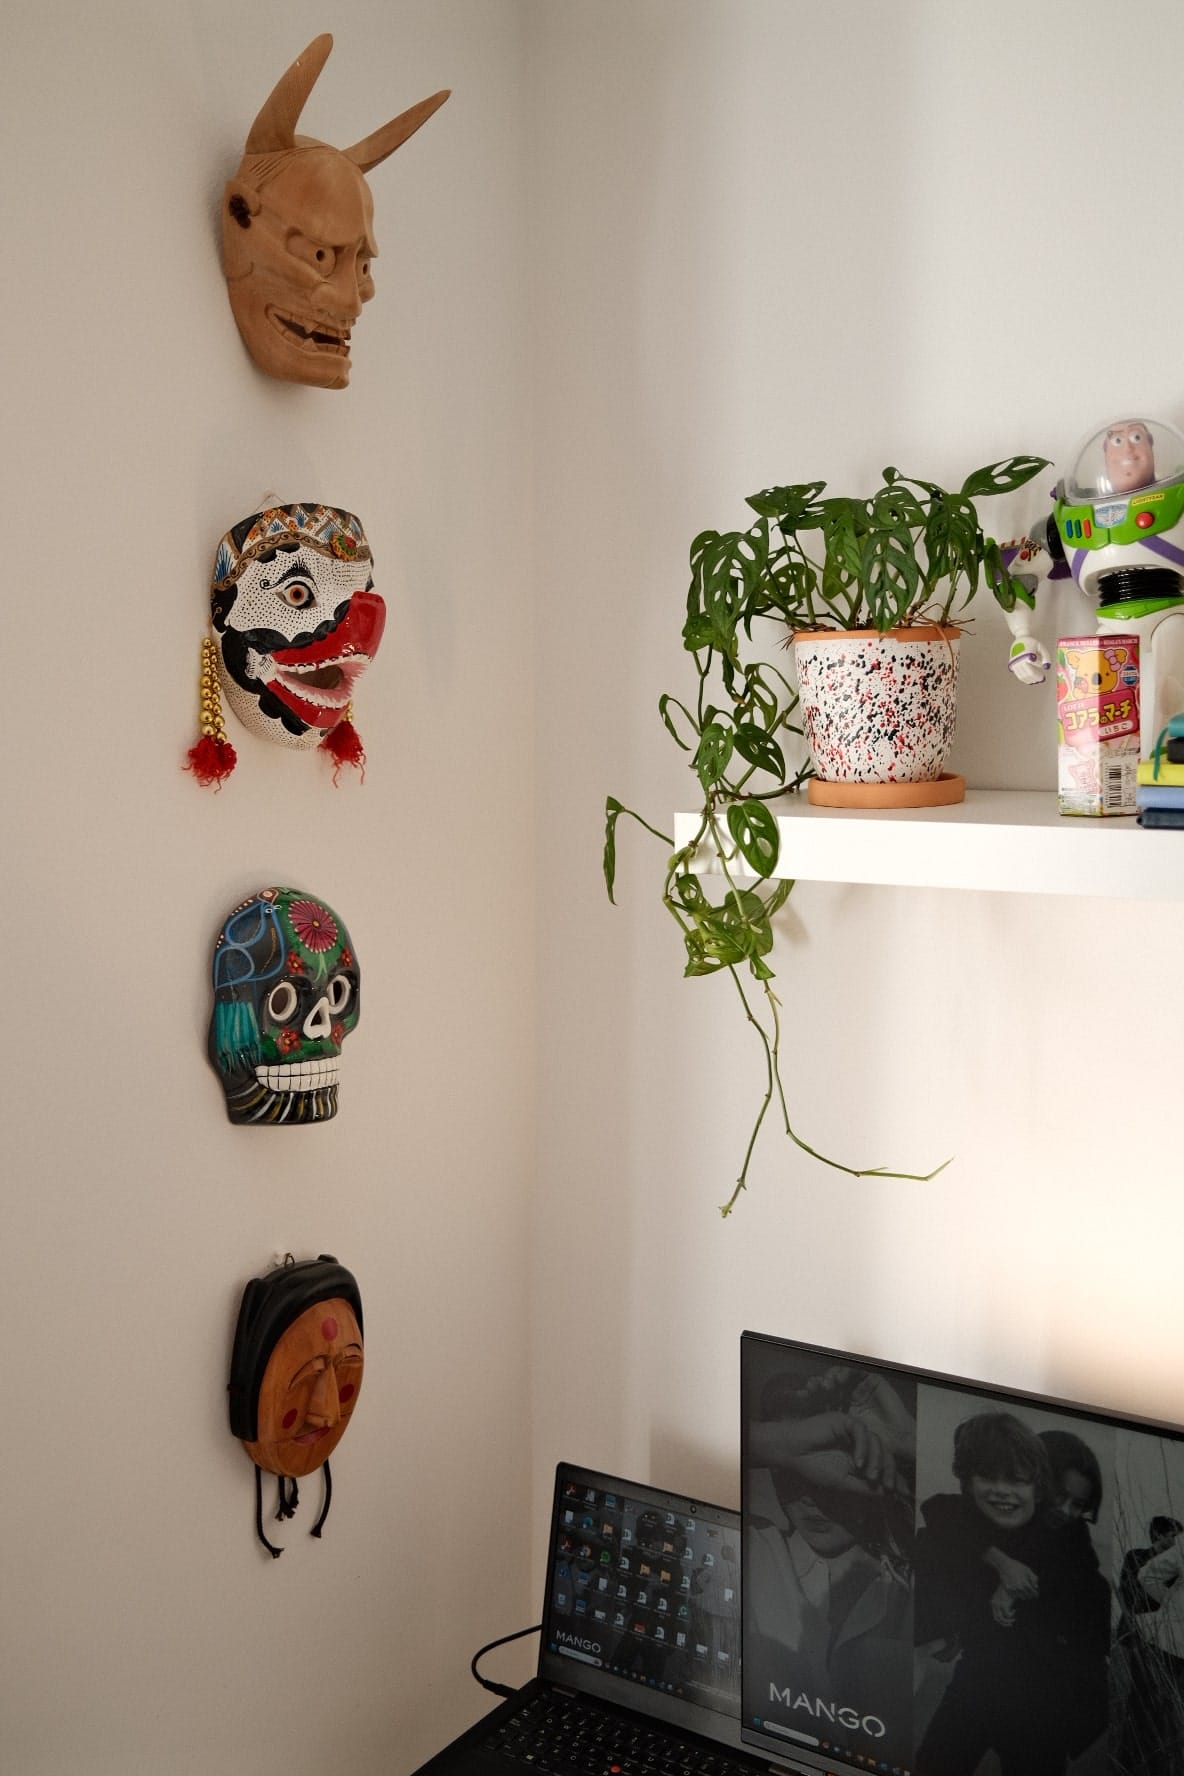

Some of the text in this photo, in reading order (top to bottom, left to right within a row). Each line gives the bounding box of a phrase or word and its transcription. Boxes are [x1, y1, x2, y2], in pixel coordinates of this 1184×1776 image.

[1064, 699, 1131, 730] コアラのマーチ
[556, 1630, 601, 1653] MANGO
[769, 1682, 886, 1738] MANGO
